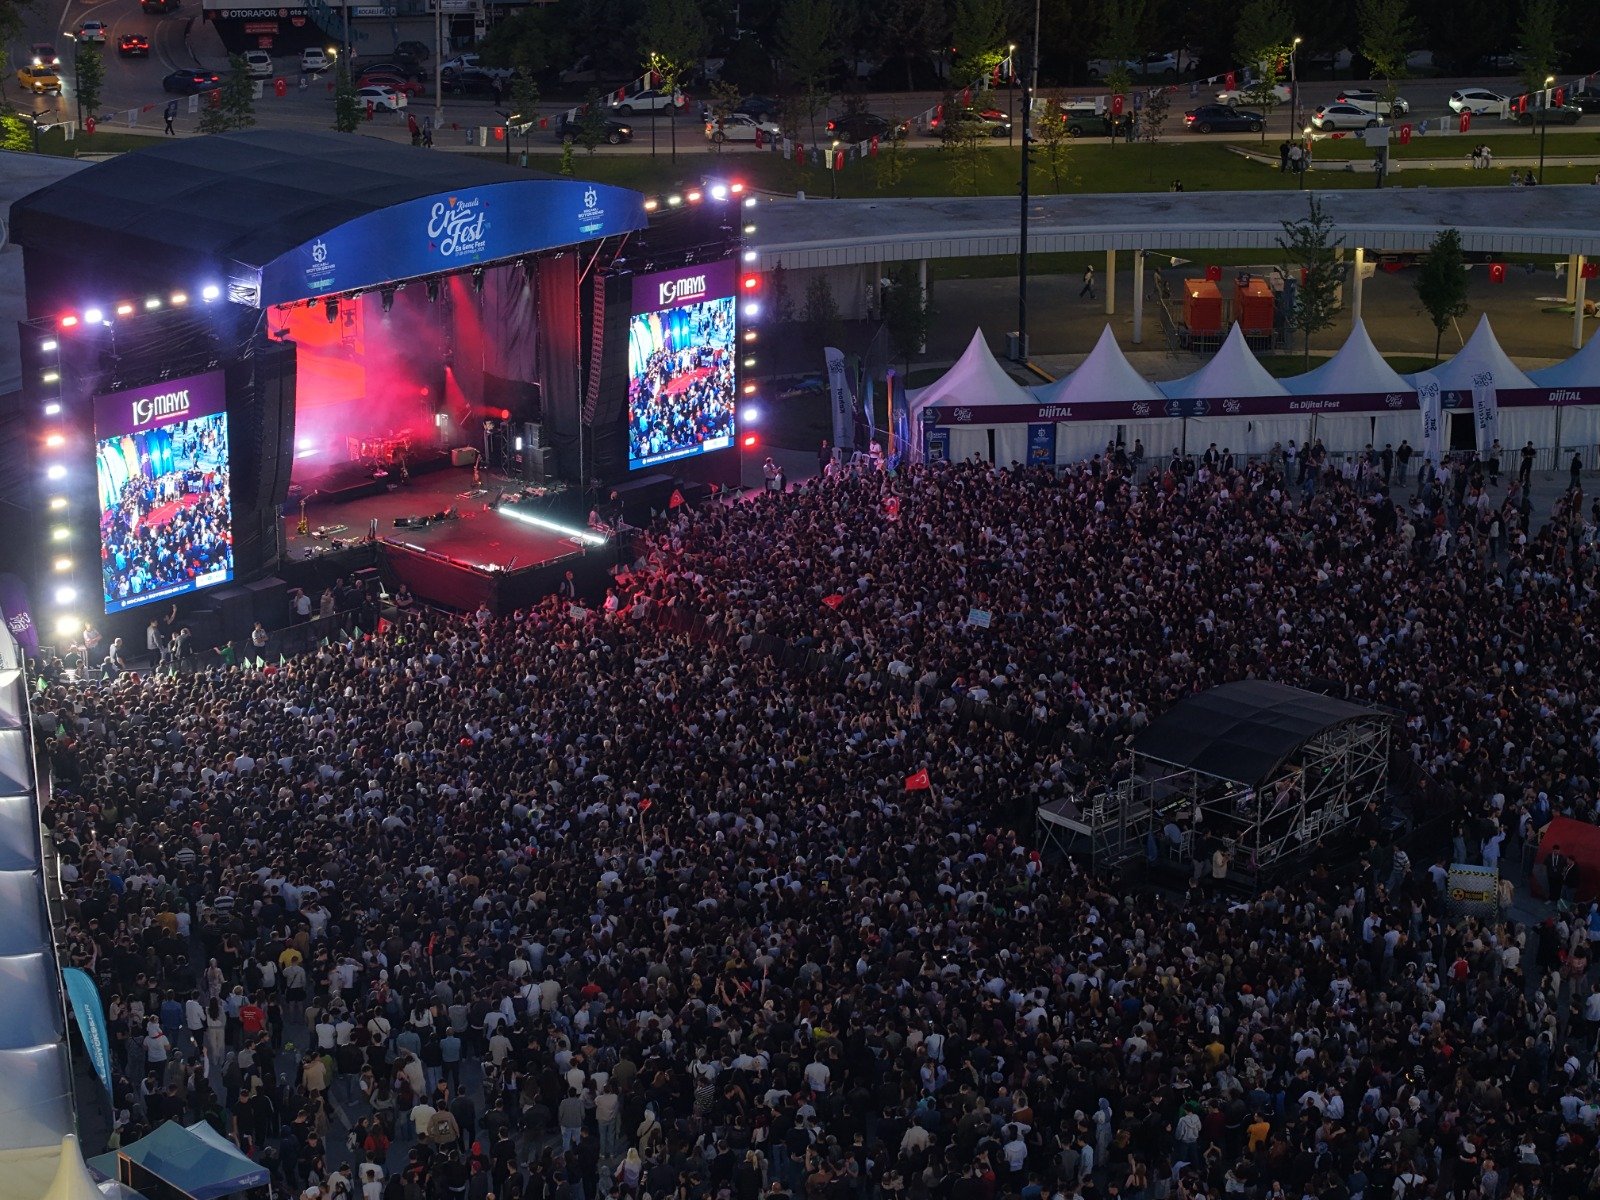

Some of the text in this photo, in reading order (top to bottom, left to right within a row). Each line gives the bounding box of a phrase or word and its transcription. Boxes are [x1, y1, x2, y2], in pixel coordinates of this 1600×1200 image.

[230, 9, 277, 18] OTORAPOR
[428, 202, 471, 238] En
[440, 212, 486, 256] Fest
[659, 275, 706, 305] 19 MAYIS
[132, 390, 190, 426] 19 MAYIS
[1289, 400, 1340, 410] En Dijital Fest
